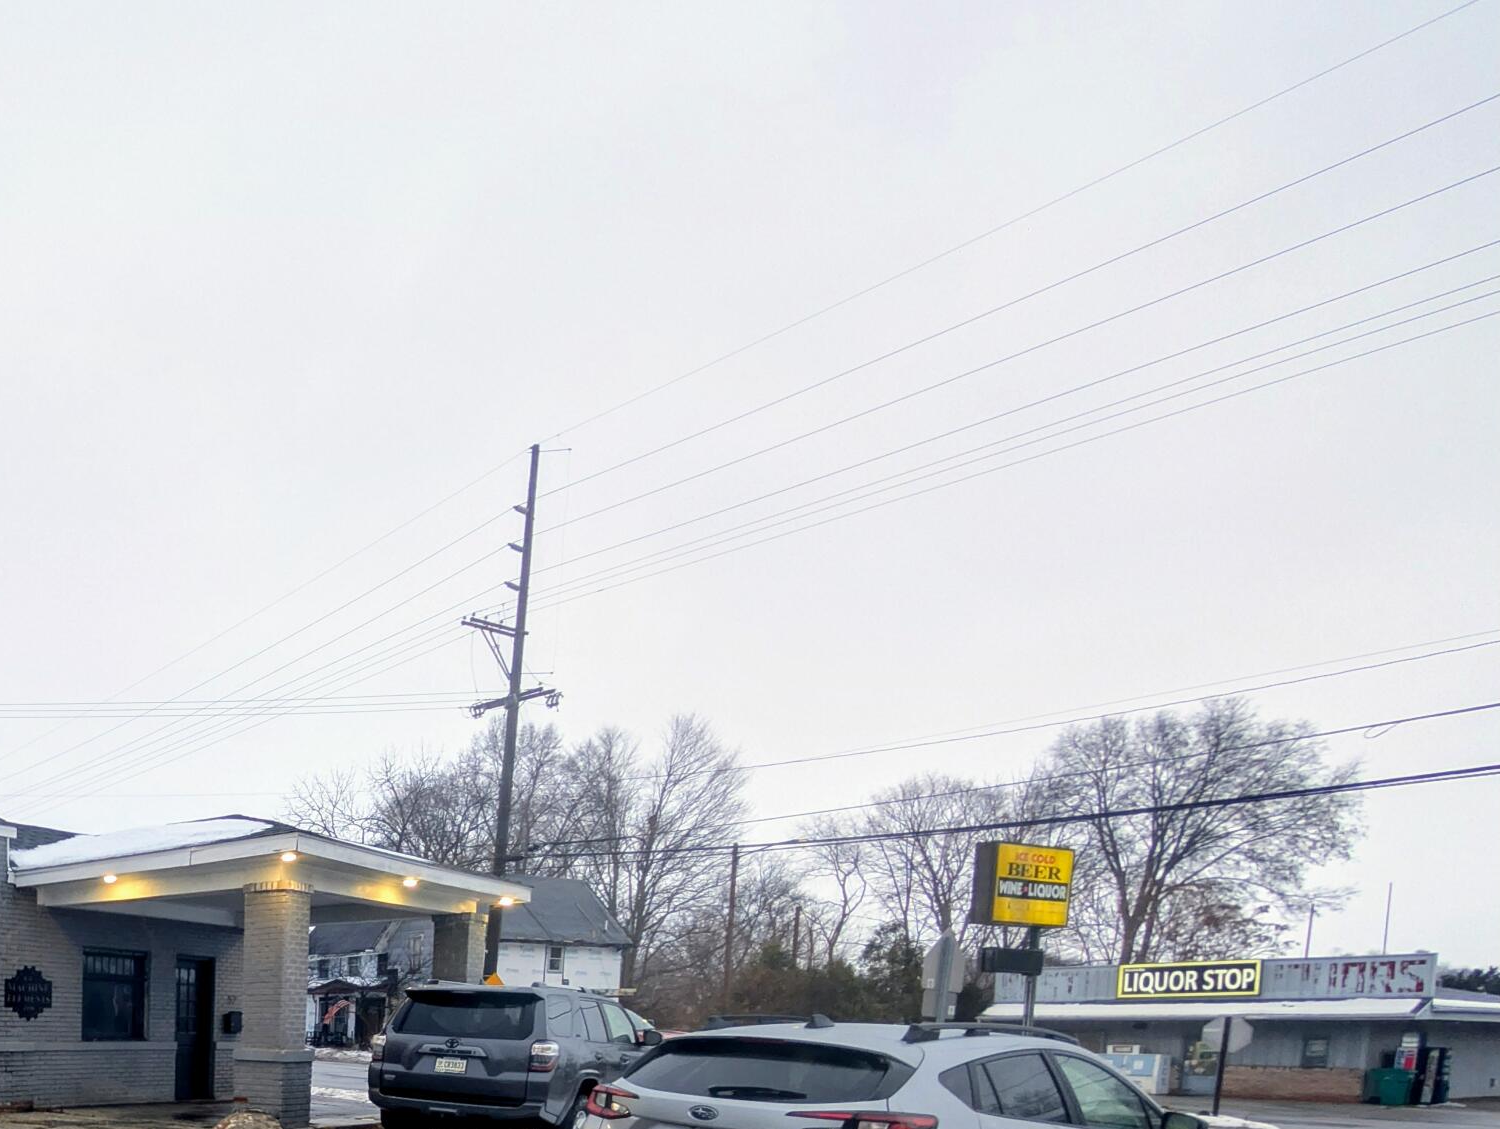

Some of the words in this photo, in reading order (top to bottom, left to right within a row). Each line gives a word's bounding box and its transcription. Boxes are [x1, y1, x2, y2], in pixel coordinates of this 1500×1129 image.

[1031, 853, 1056, 865] COLD
[1008, 862, 1062, 881] BEER
[999, 880, 1024, 896] WINE
[1028, 882, 1067, 900] LIQUOR
[1123, 970, 1198, 994] LIQUOR
[1202, 968, 1256, 991] STOP
